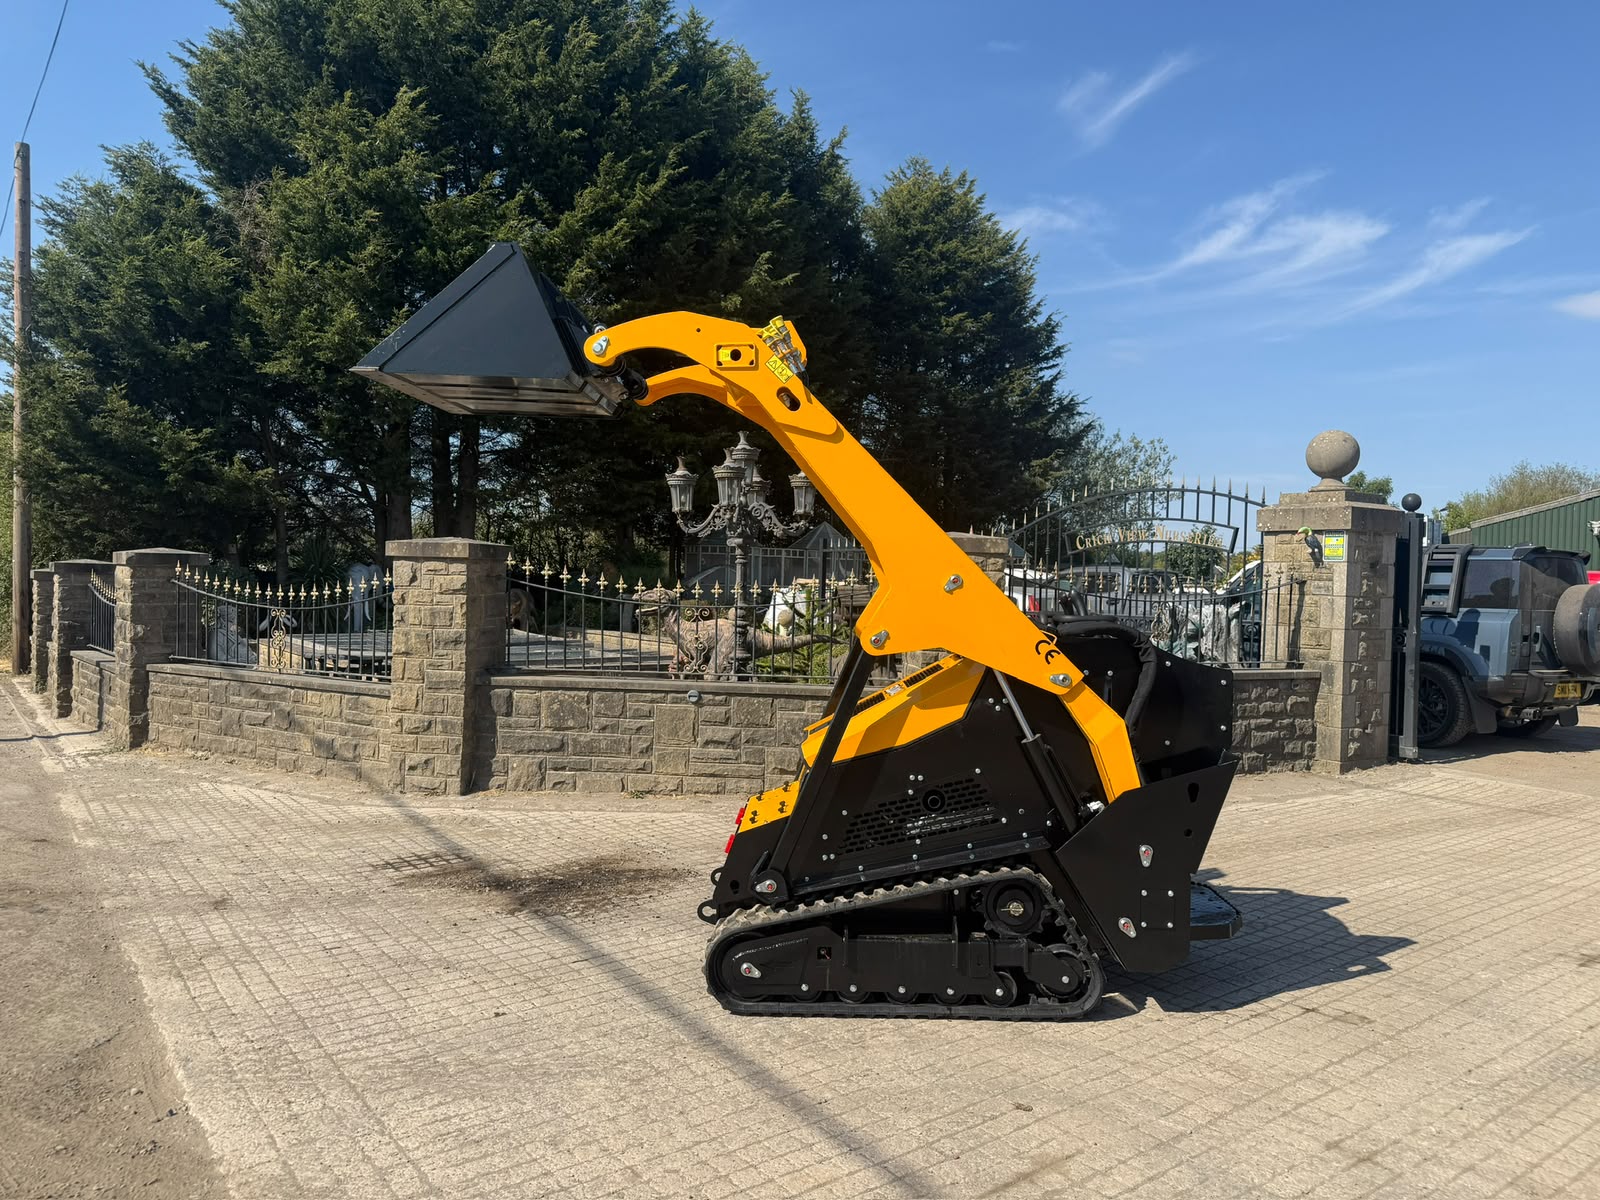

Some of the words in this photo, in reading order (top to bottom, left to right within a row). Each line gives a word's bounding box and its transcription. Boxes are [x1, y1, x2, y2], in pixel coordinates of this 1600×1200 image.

[1118, 526, 1147, 542] VIEW
[1154, 524, 1223, 547] NURSERIES
[1035, 640, 1061, 665] CE
